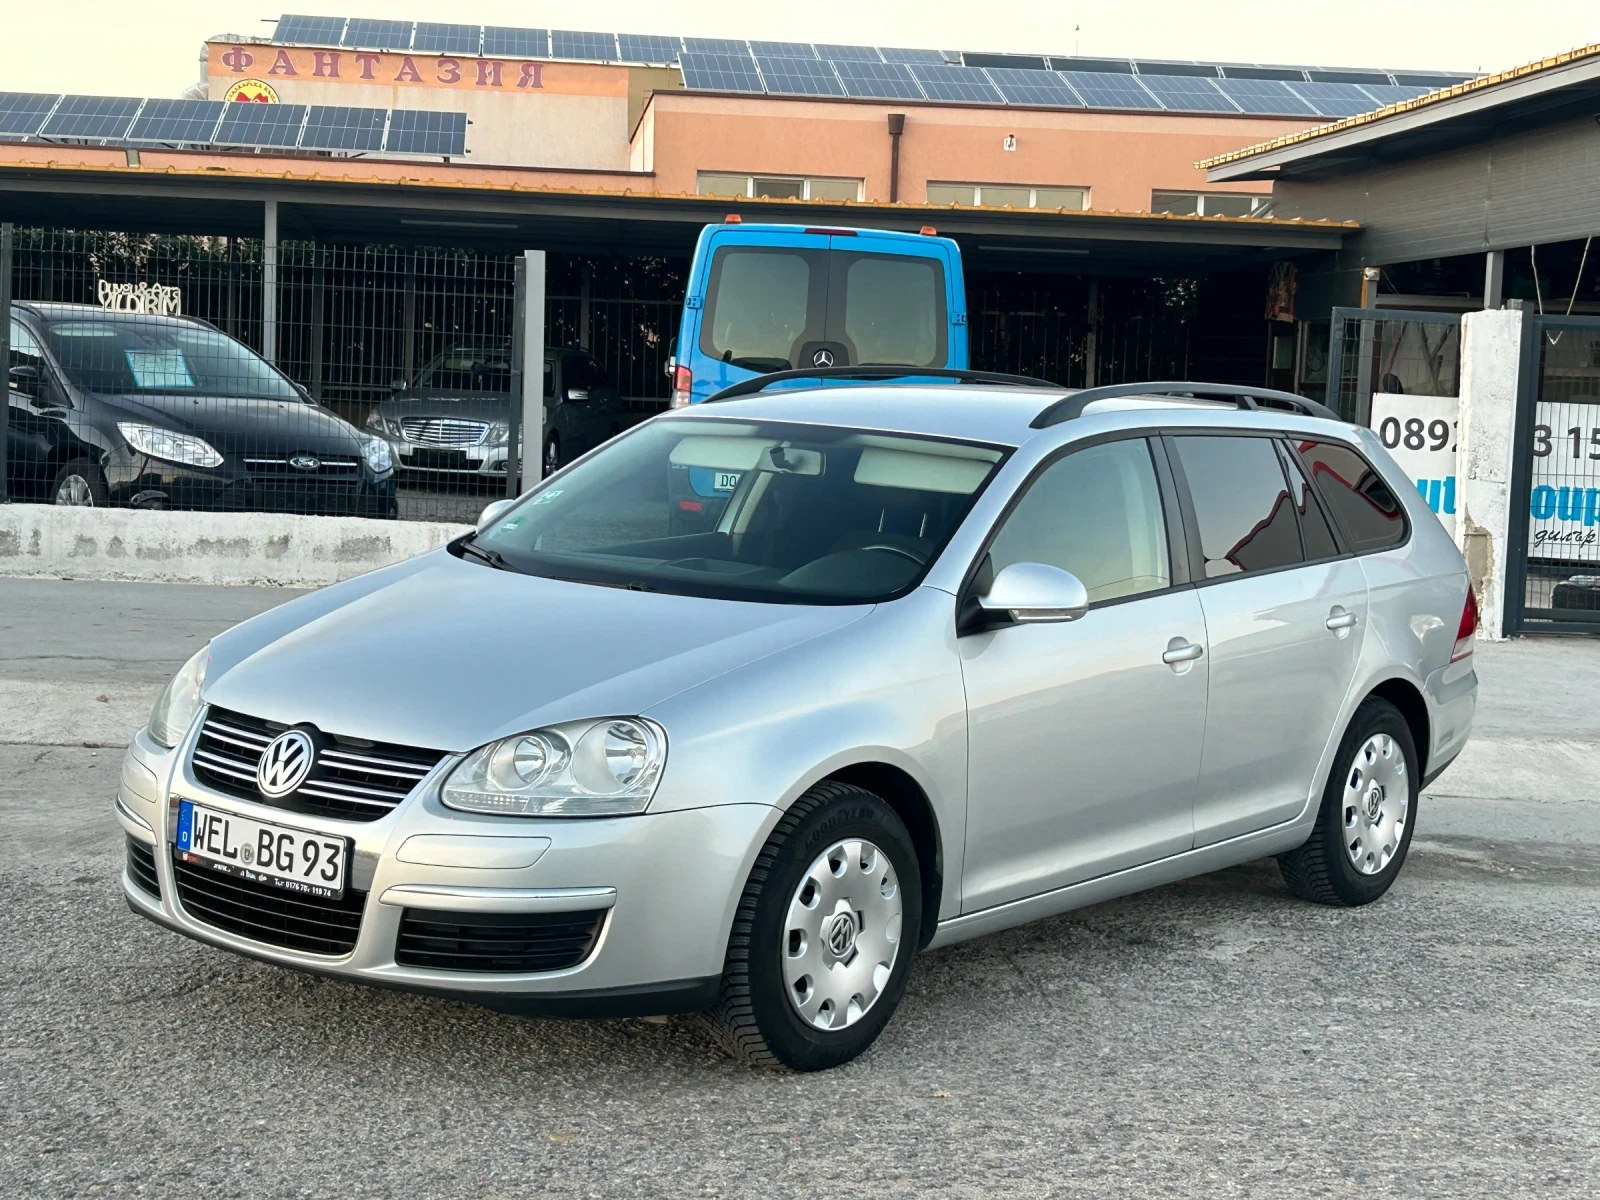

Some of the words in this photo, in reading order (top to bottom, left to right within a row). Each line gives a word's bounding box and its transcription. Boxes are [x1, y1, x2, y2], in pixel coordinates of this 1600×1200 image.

[221, 46, 545, 89] ФАНТАЗИЯ
[193, 810, 238, 860] WEL
[256, 828, 295, 873] BG
[302, 839, 340, 881] 93
